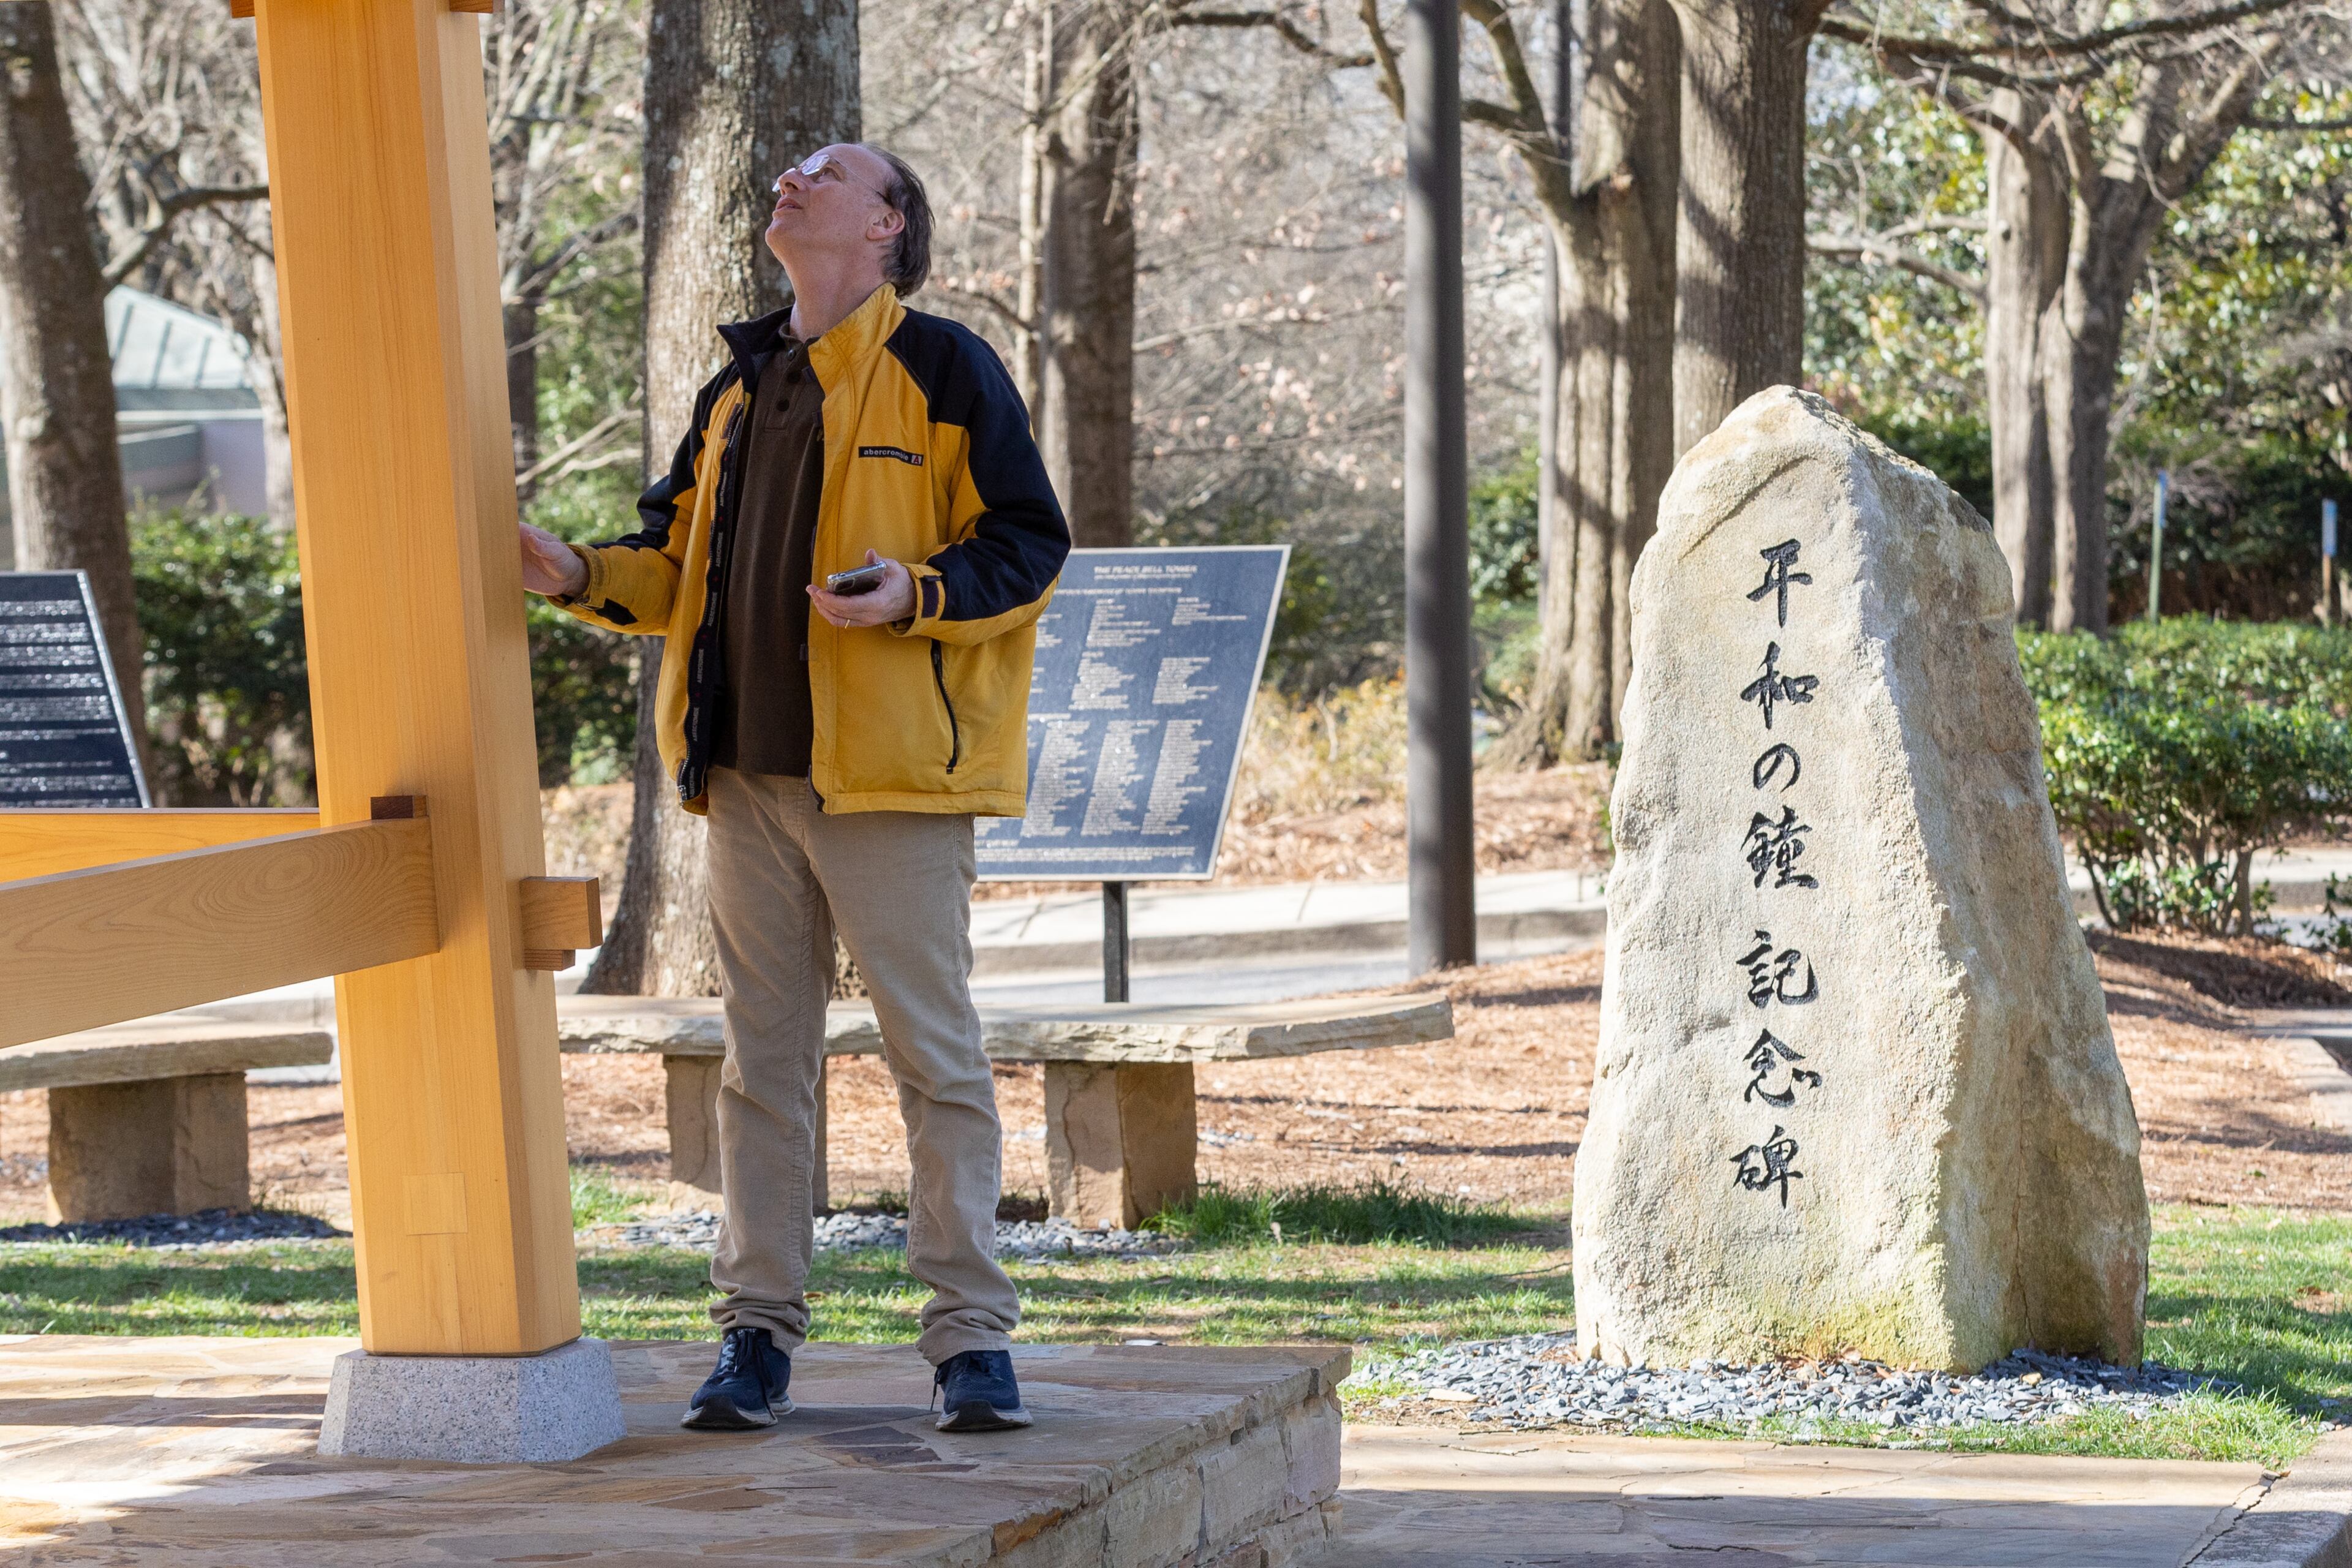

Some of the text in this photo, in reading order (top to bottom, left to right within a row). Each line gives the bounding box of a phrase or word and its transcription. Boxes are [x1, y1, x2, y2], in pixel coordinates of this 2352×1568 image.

[864, 448, 908, 461] abercrombie
[1093, 564, 1198, 574] THE PEACE BELL TOWER
[707, 592, 718, 627] ABERCROMBIE
[1730, 539, 1822, 1209] 平和の鐘記念碑
